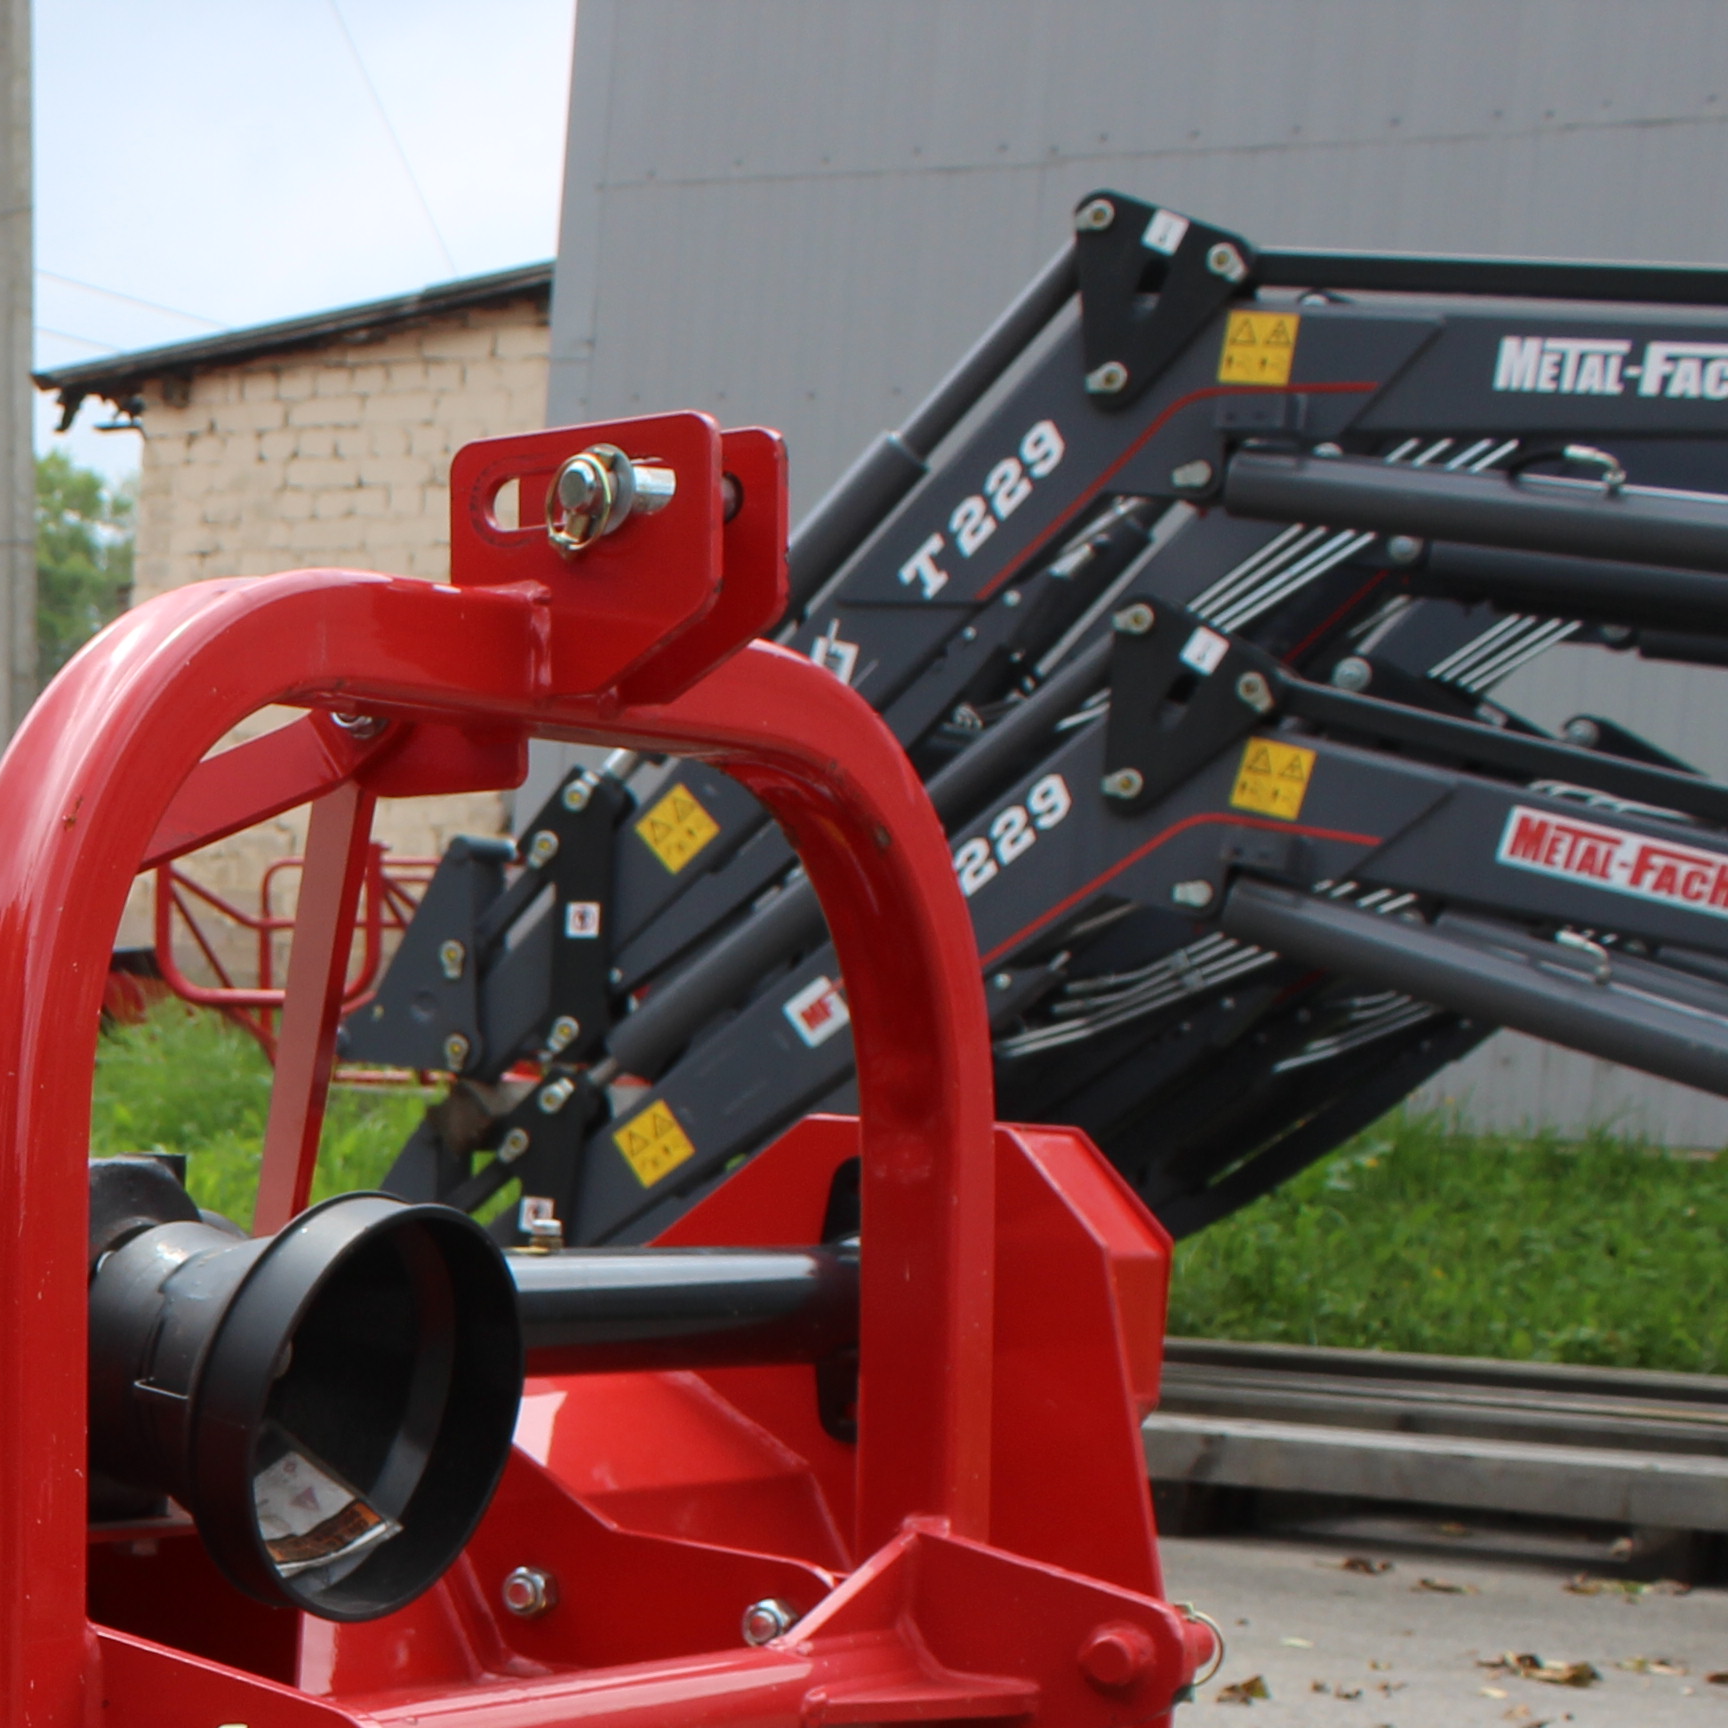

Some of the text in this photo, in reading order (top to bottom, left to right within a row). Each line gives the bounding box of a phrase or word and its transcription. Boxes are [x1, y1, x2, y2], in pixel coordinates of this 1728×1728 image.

[898, 419, 1066, 600] T 229
[953, 773, 1072, 898] 229
